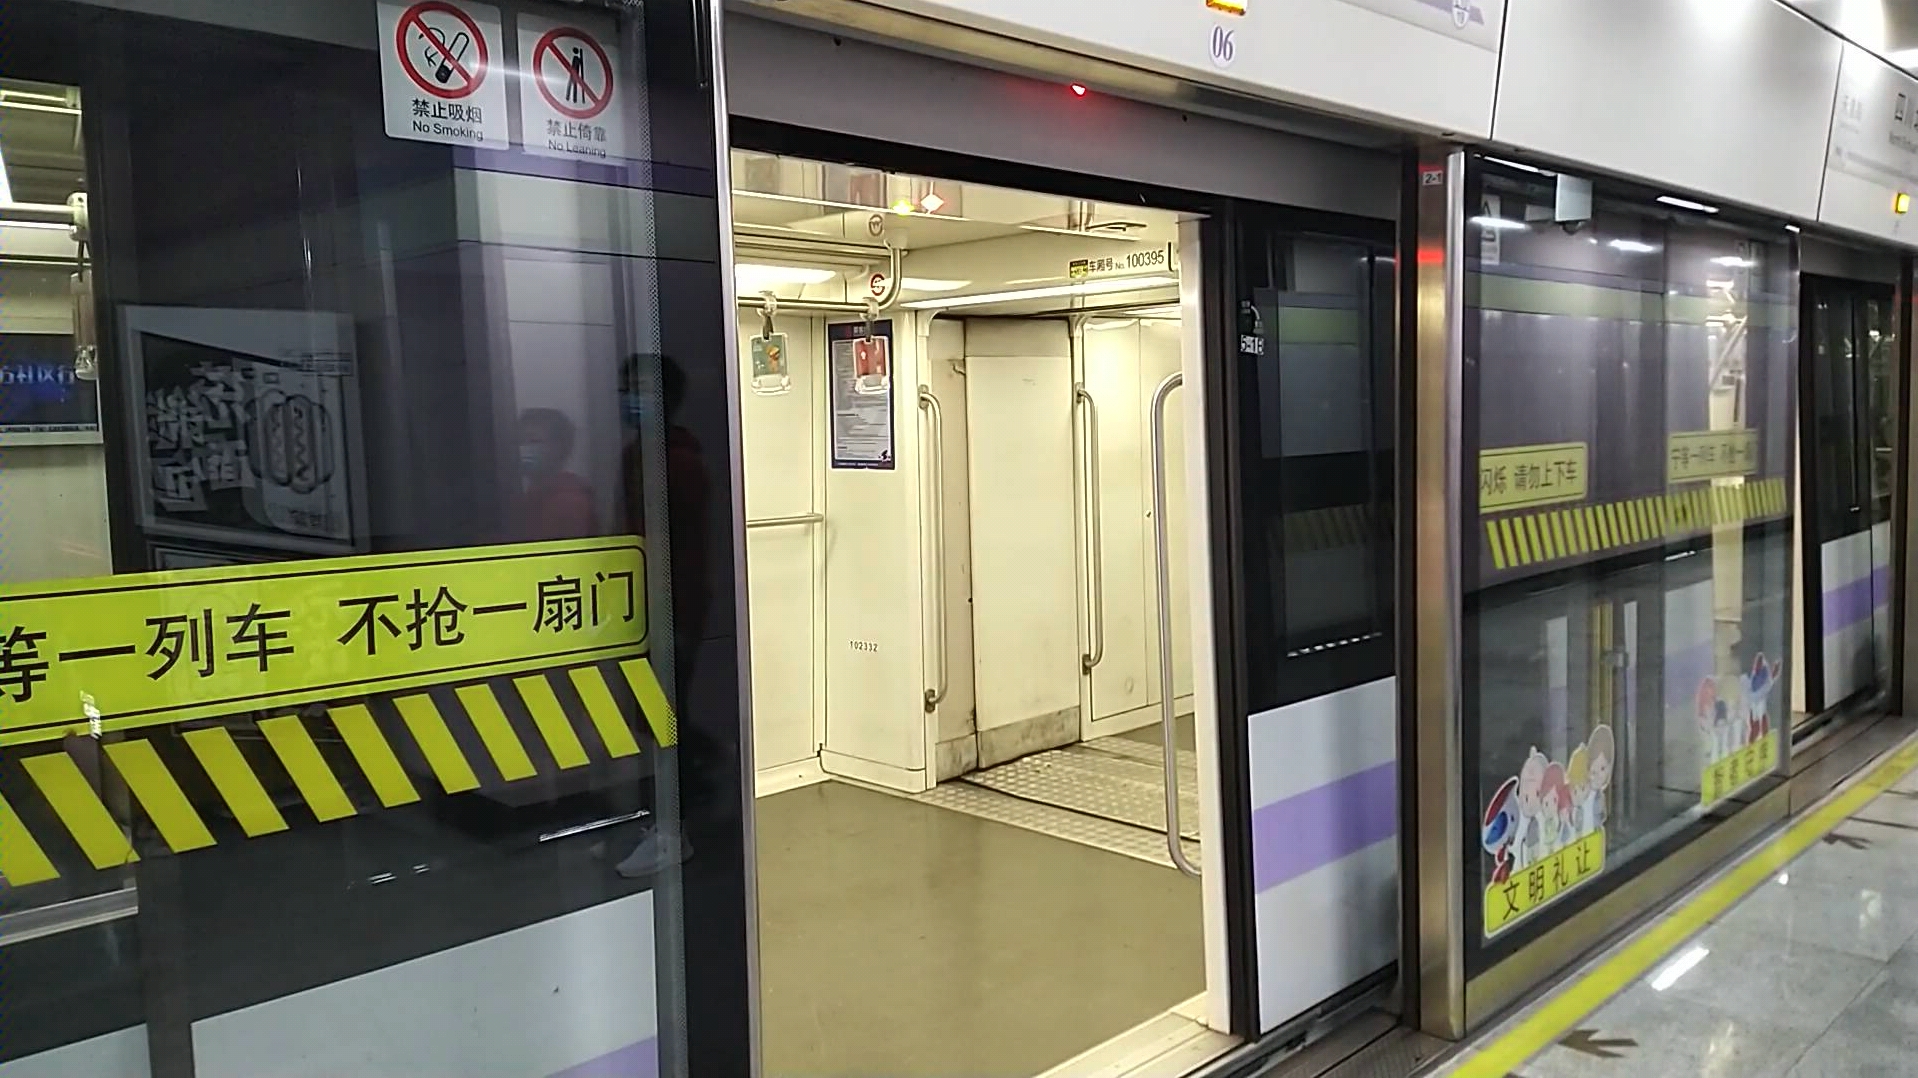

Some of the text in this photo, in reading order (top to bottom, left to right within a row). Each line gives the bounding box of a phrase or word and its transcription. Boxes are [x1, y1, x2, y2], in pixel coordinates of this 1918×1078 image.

[1212, 25, 1235, 61] 06
[412, 98, 483, 124] 禁止吸烟
[412, 120, 484, 142] No Smoking
[546, 118, 607, 142] 禁止倚靠
[547, 138, 606, 159] No Leaning
[1424, 172, 1442, 184] 2-1
[1088, 258, 1113, 273] 车厢号
[1126, 249, 1165, 269] 100395
[1514, 460, 1577, 491] 请勿上下车
[0, 571, 635, 702] 等一列车 不抢一扇门
[849, 640, 879, 652] 102332
[1503, 841, 1591, 920] 文明礼让
